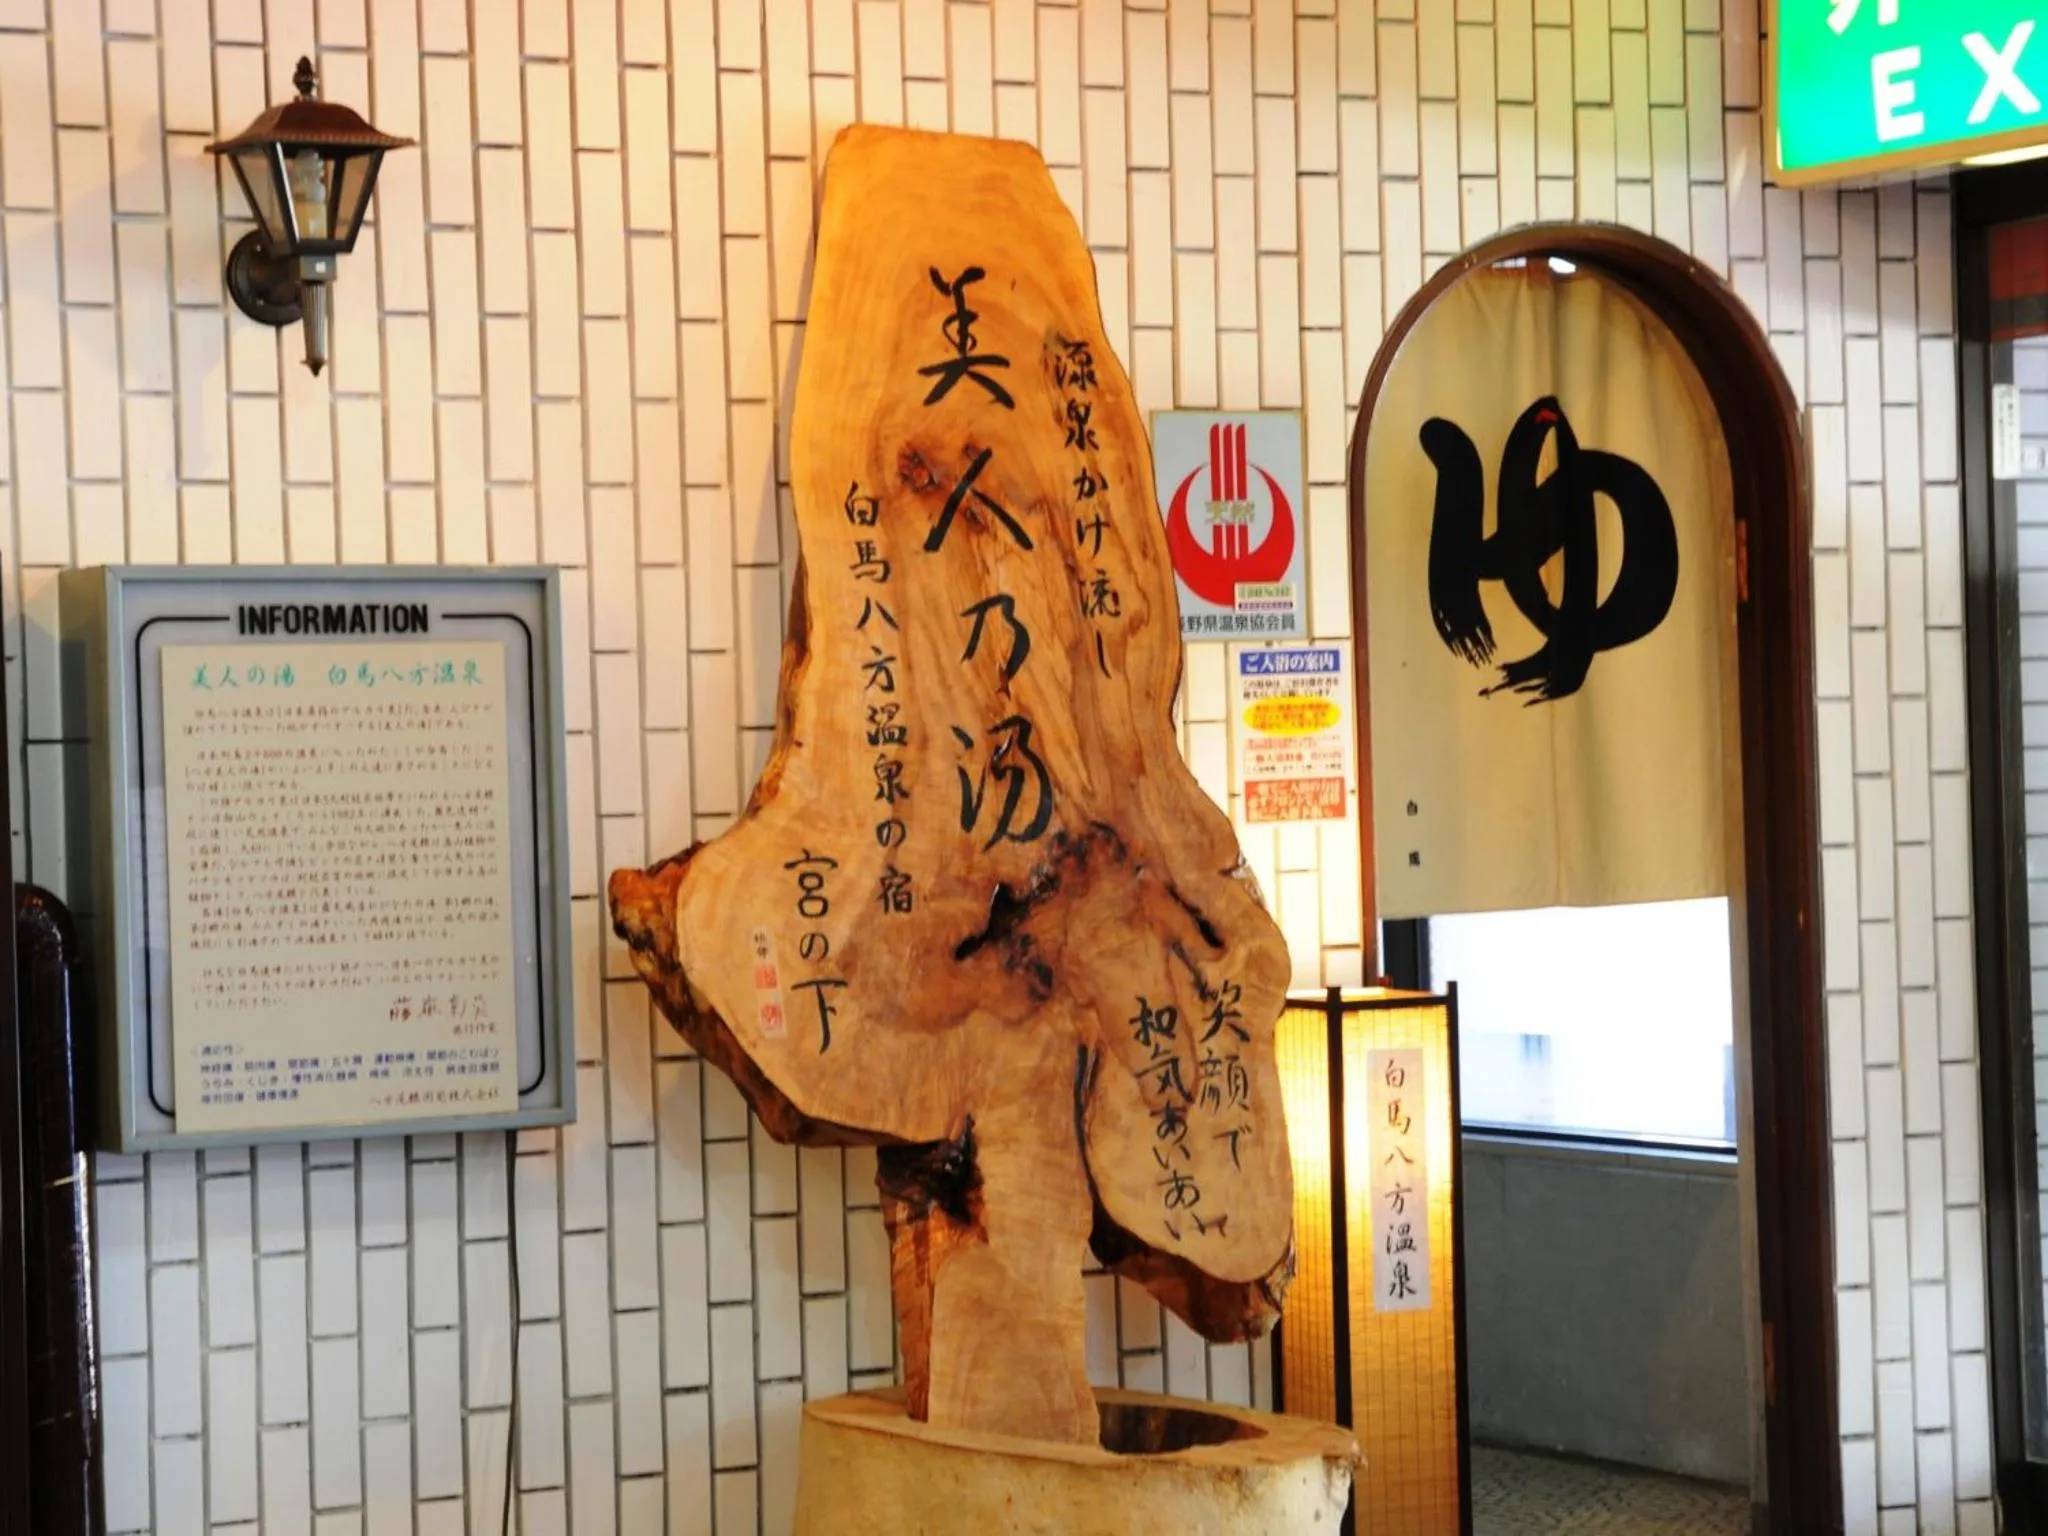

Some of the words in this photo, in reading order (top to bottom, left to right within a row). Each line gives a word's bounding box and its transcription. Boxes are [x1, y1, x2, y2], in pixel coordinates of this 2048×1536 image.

[238, 604, 429, 636] INFORMATION
[918, 265, 1053, 853] 美人乃湯
[1054, 331, 1121, 680] 源泉かけ流し
[1419, 396, 1678, 708] ゆ
[191, 663, 296, 690] 美人の湯
[327, 659, 484, 688] 白馬八方温泉
[844, 481, 913, 916] 白馬八方温泉の宿
[784, 848, 849, 1055] 宮の下
[1200, 980, 1252, 1172] 笑顔で
[1384, 1059, 1417, 1299] 白馬八方温泉
